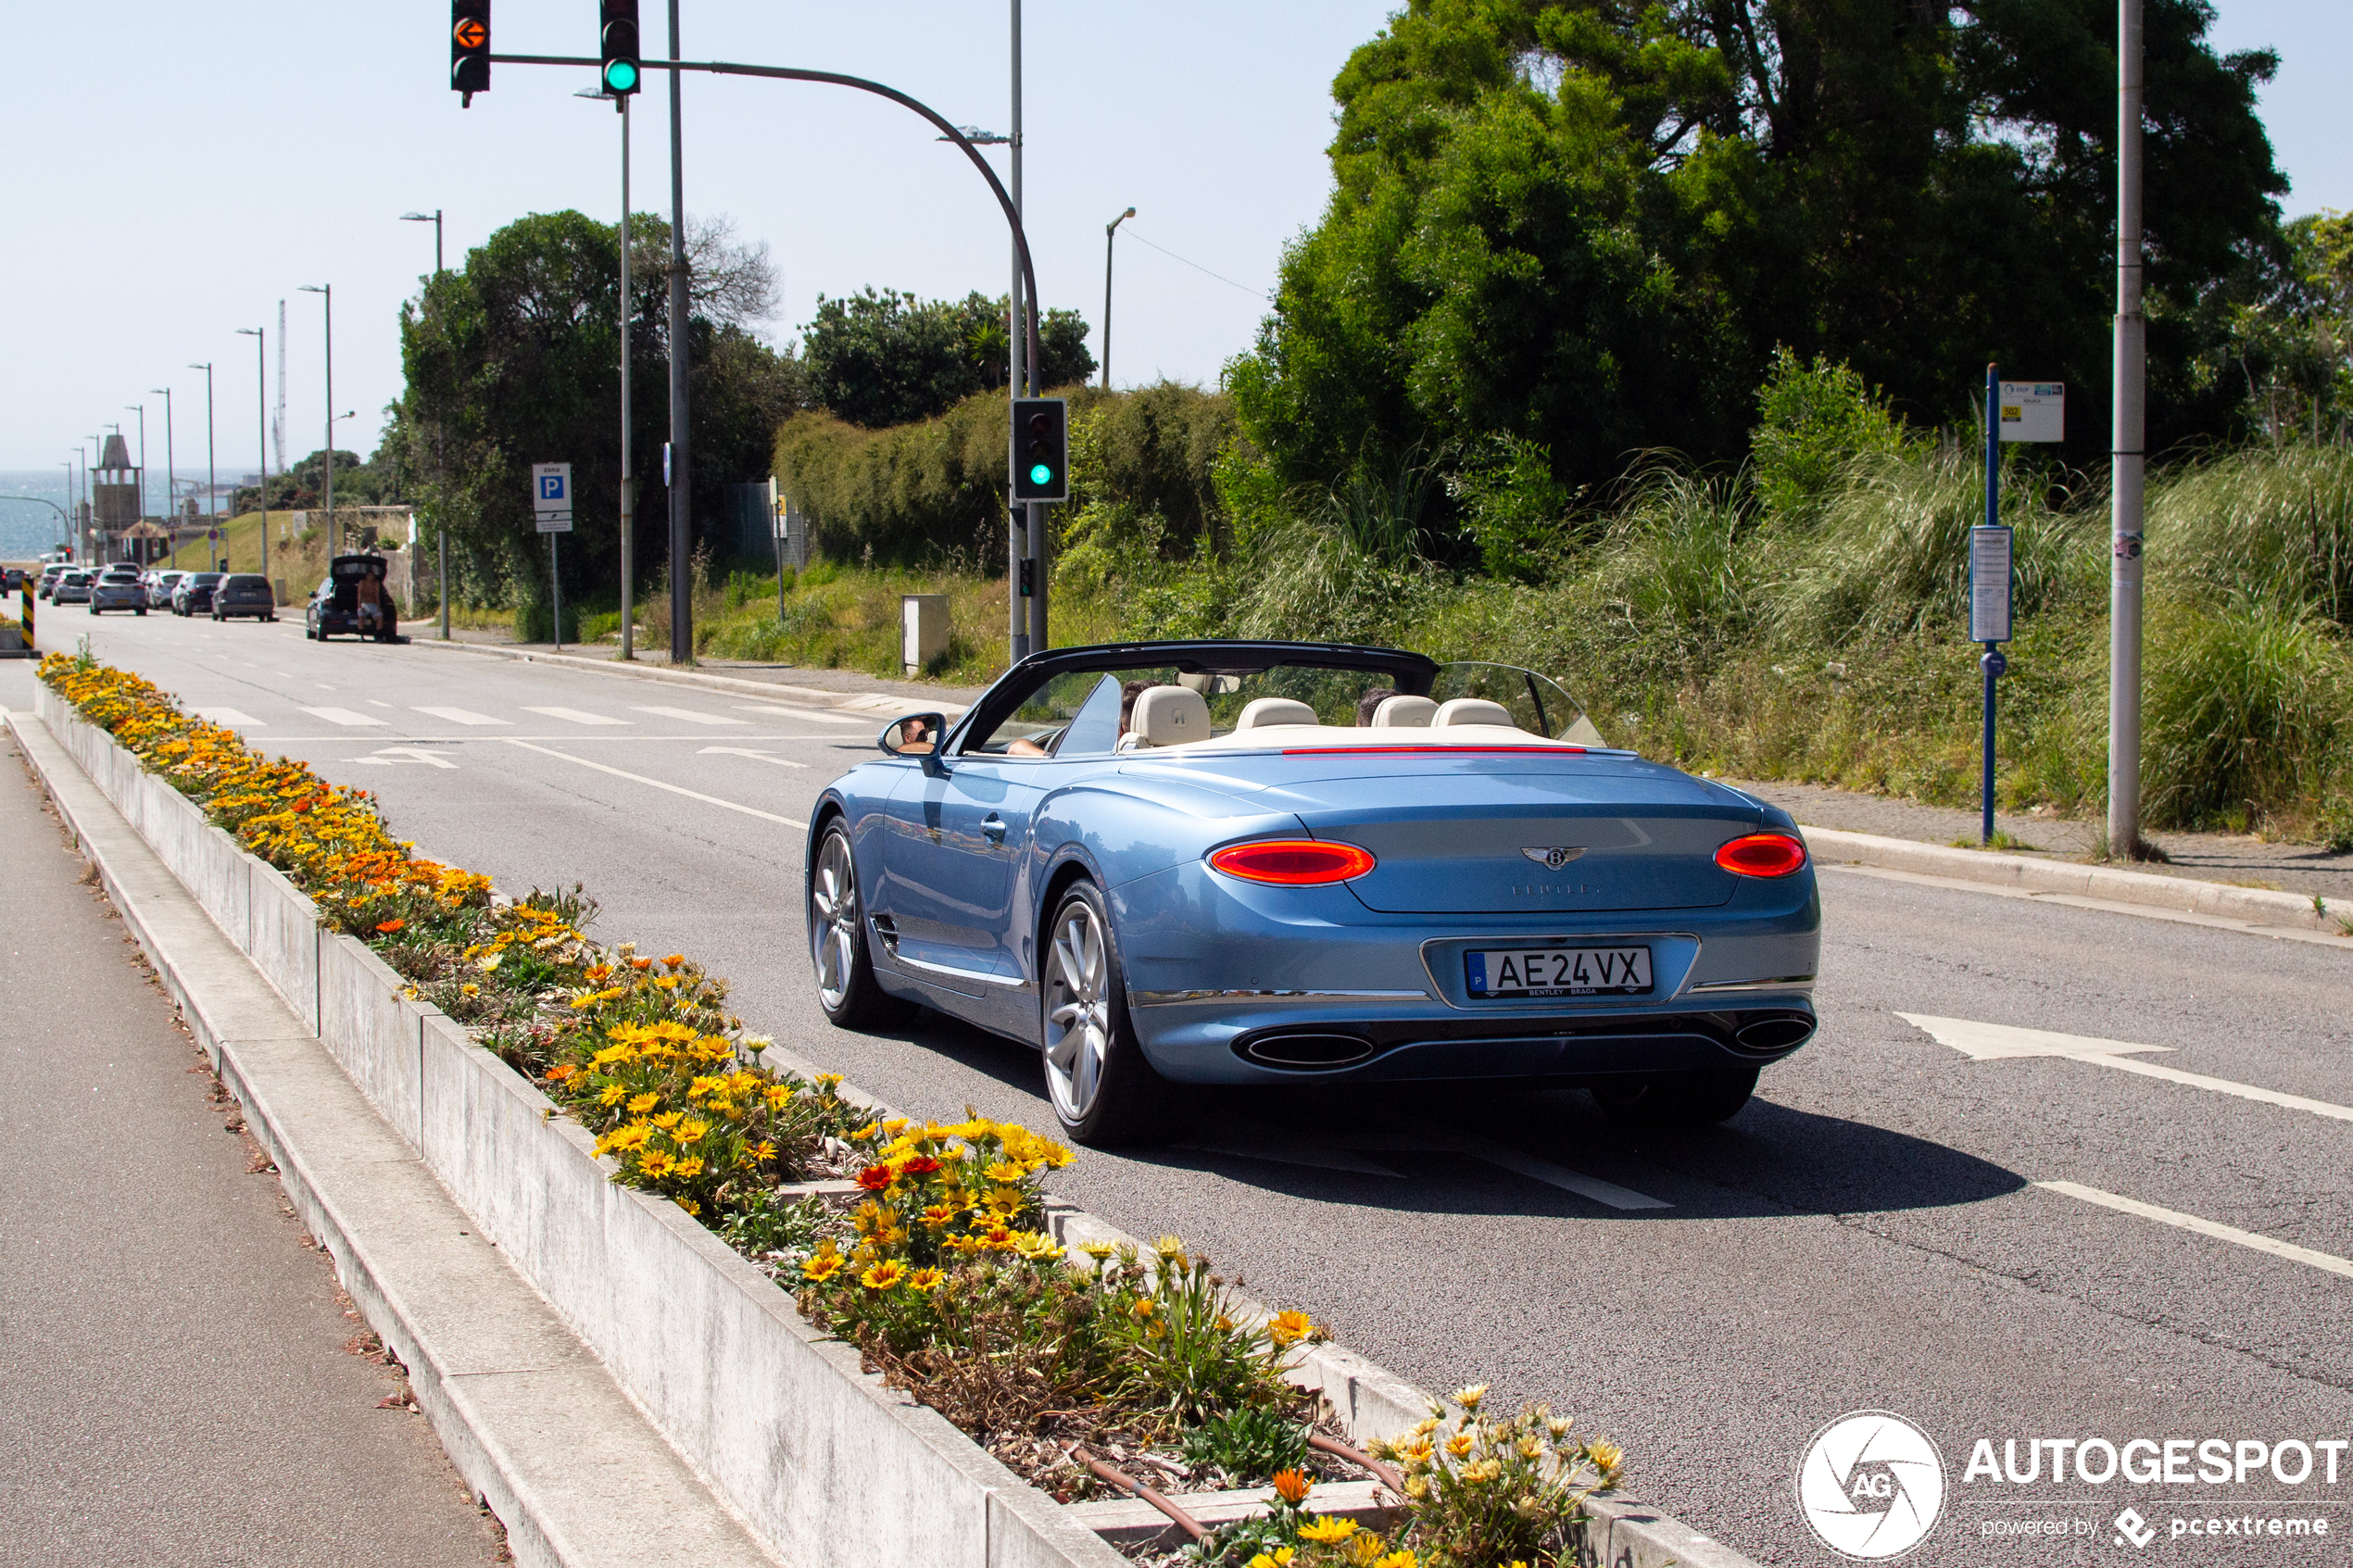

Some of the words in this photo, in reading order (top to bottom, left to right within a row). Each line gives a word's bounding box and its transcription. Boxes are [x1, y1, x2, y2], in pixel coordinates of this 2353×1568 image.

[2004, 407, 2019, 416] 502
[545, 478, 559, 497] P
[1549, 851, 1563, 865] B
[1475, 976, 1482, 985] P
[1529, 988, 1564, 997] BENTLEY
